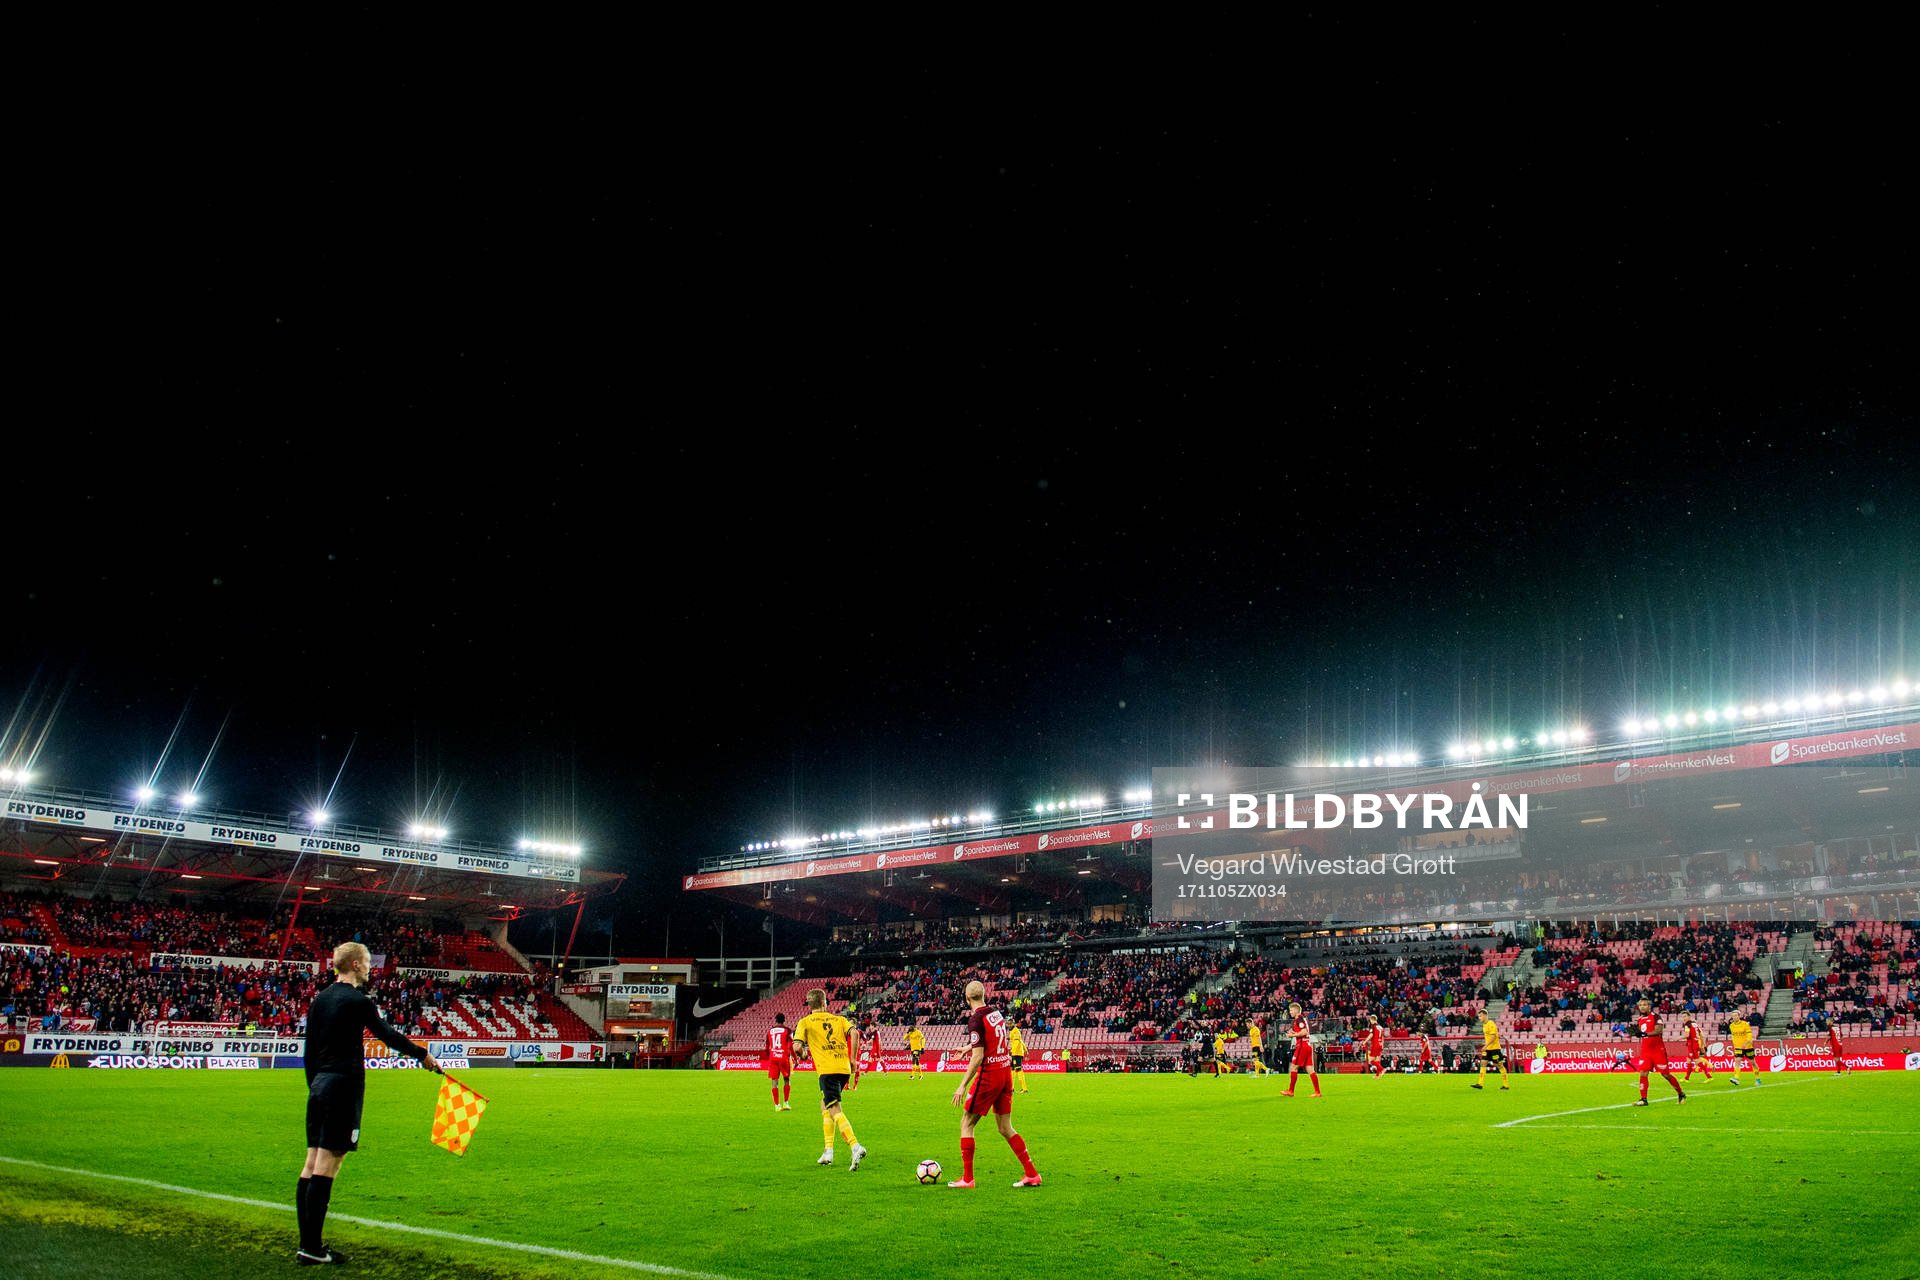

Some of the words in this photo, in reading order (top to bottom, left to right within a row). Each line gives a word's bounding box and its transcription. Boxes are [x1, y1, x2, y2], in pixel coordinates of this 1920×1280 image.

[772, 1033, 782, 1050] 14
[443, 1044, 463, 1053] LOS
[522, 1045, 541, 1054] LOS
[211, 1058, 256, 1068] PLAYER
